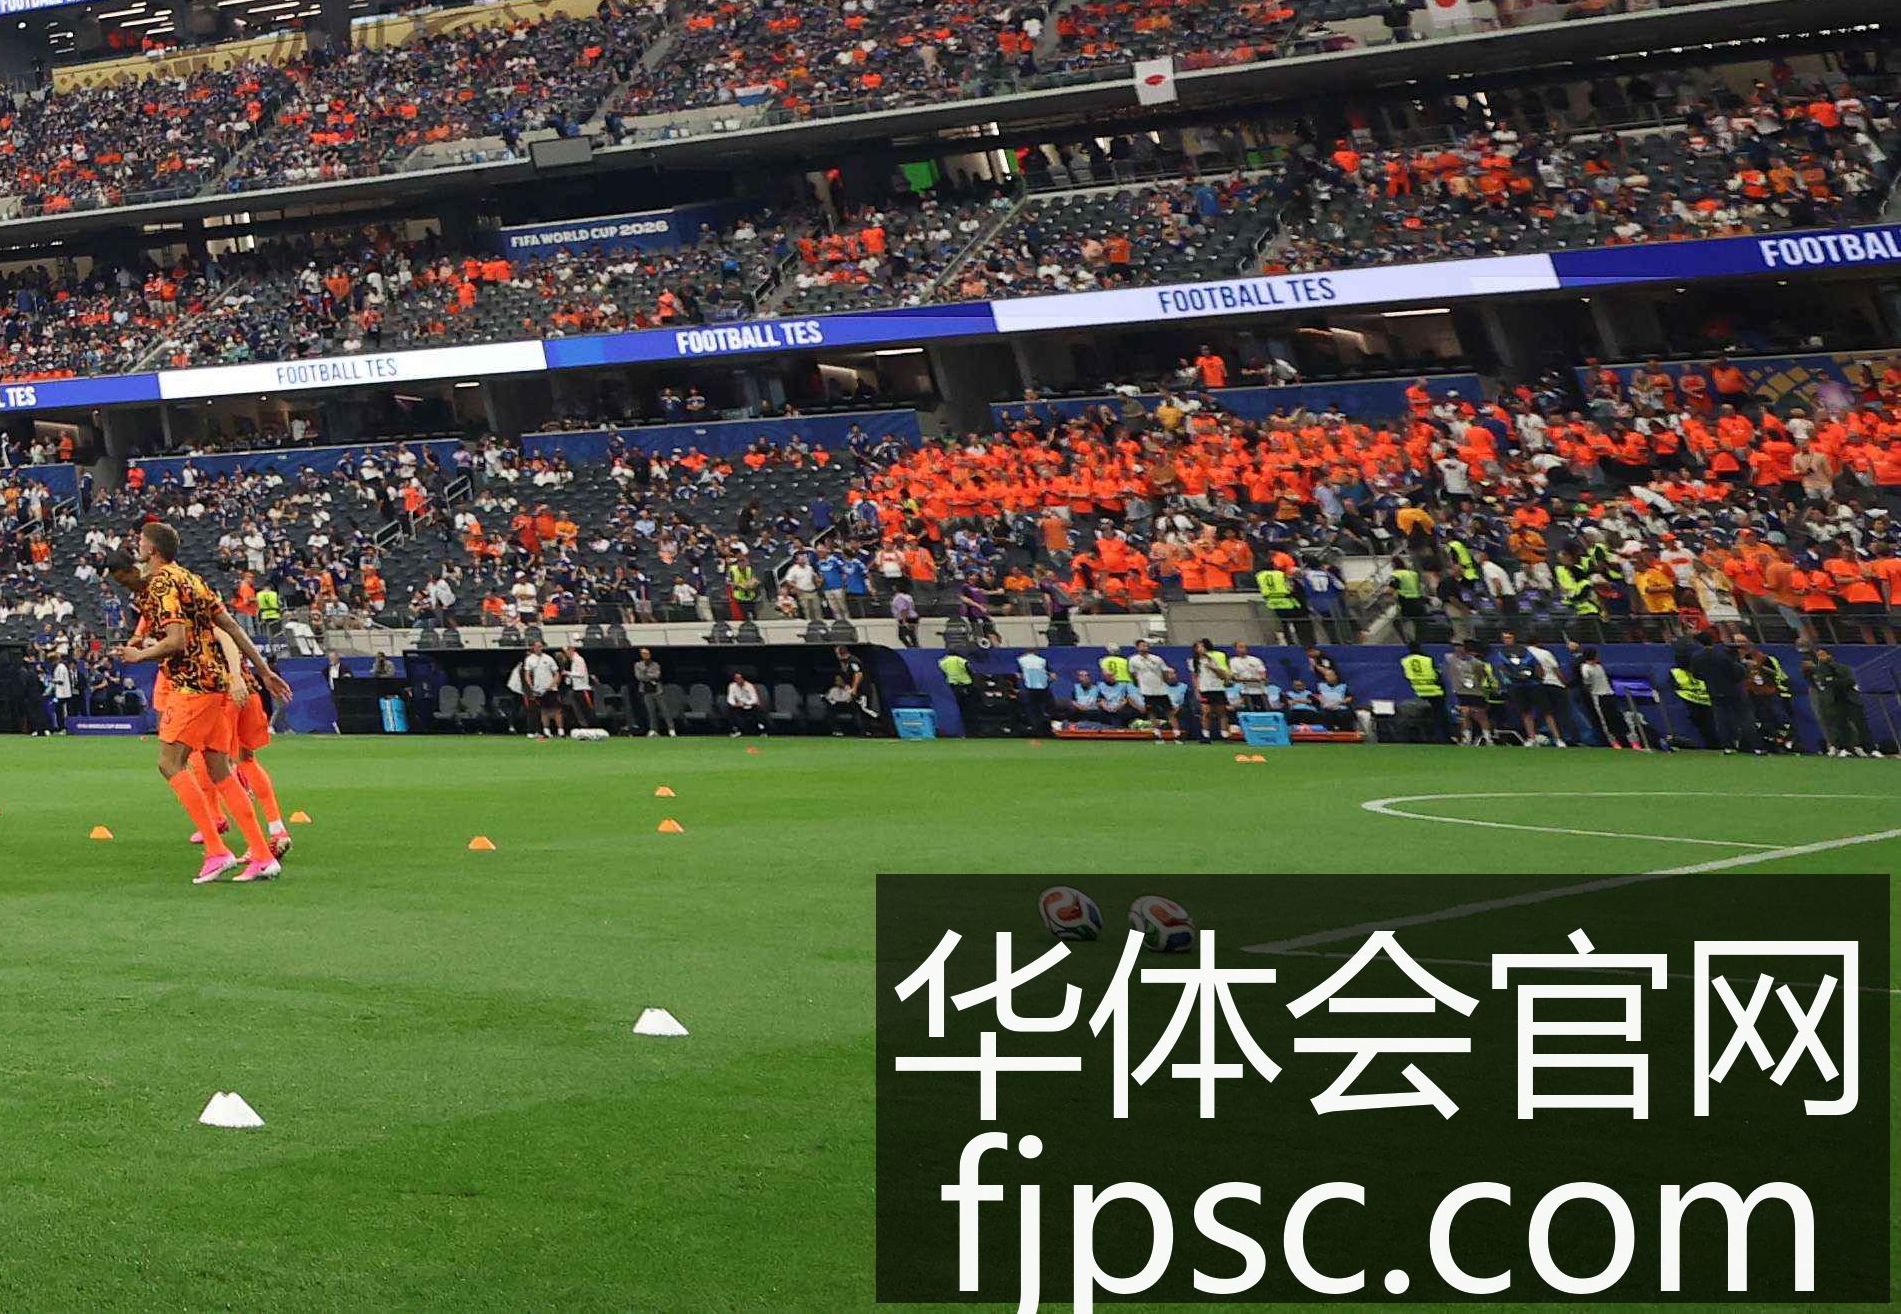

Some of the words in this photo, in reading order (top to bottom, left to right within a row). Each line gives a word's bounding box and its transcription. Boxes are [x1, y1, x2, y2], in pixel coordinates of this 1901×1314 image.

[511, 230, 539, 248] FIFA
[539, 228, 590, 246] WORLD
[590, 226, 618, 238] CUP
[618, 220, 669, 237] 2026
[1758, 230, 1901, 267] FOOTBAL
[1158, 282, 1283, 313] FOOTBALL
[1287, 277, 1336, 303] TES
